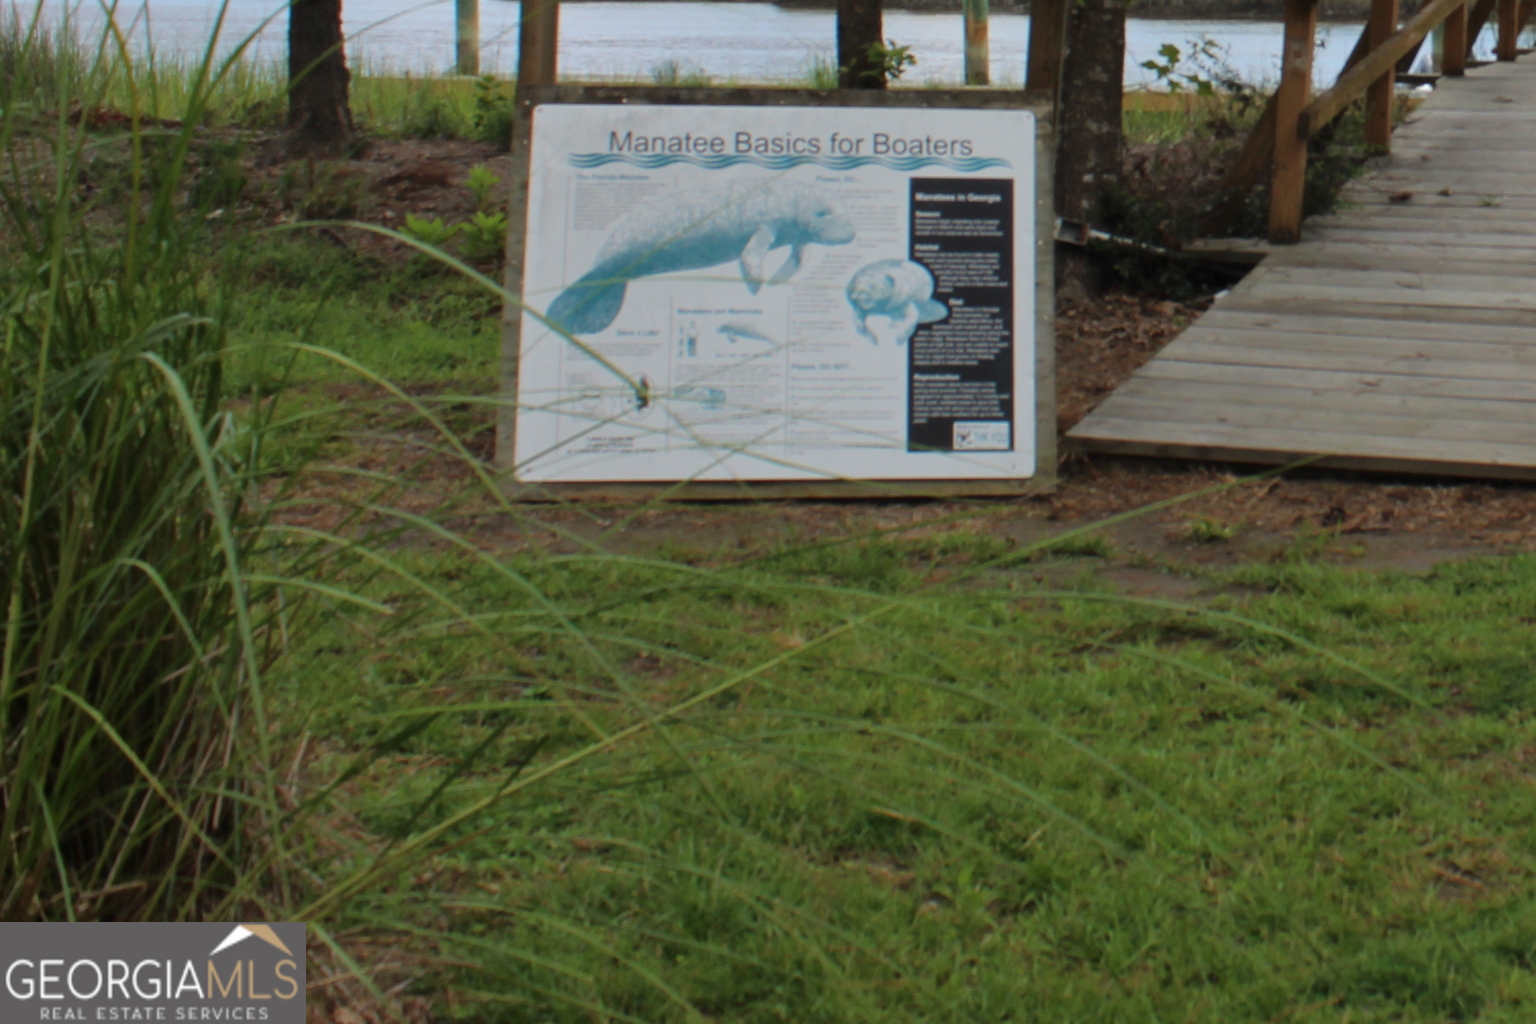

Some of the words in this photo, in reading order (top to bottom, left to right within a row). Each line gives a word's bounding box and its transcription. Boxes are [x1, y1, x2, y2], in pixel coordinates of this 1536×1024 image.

[609, 131, 725, 153] Manatee
[734, 131, 821, 154] Basics
[830, 132, 864, 154] for
[873, 133, 973, 156] Boaters
